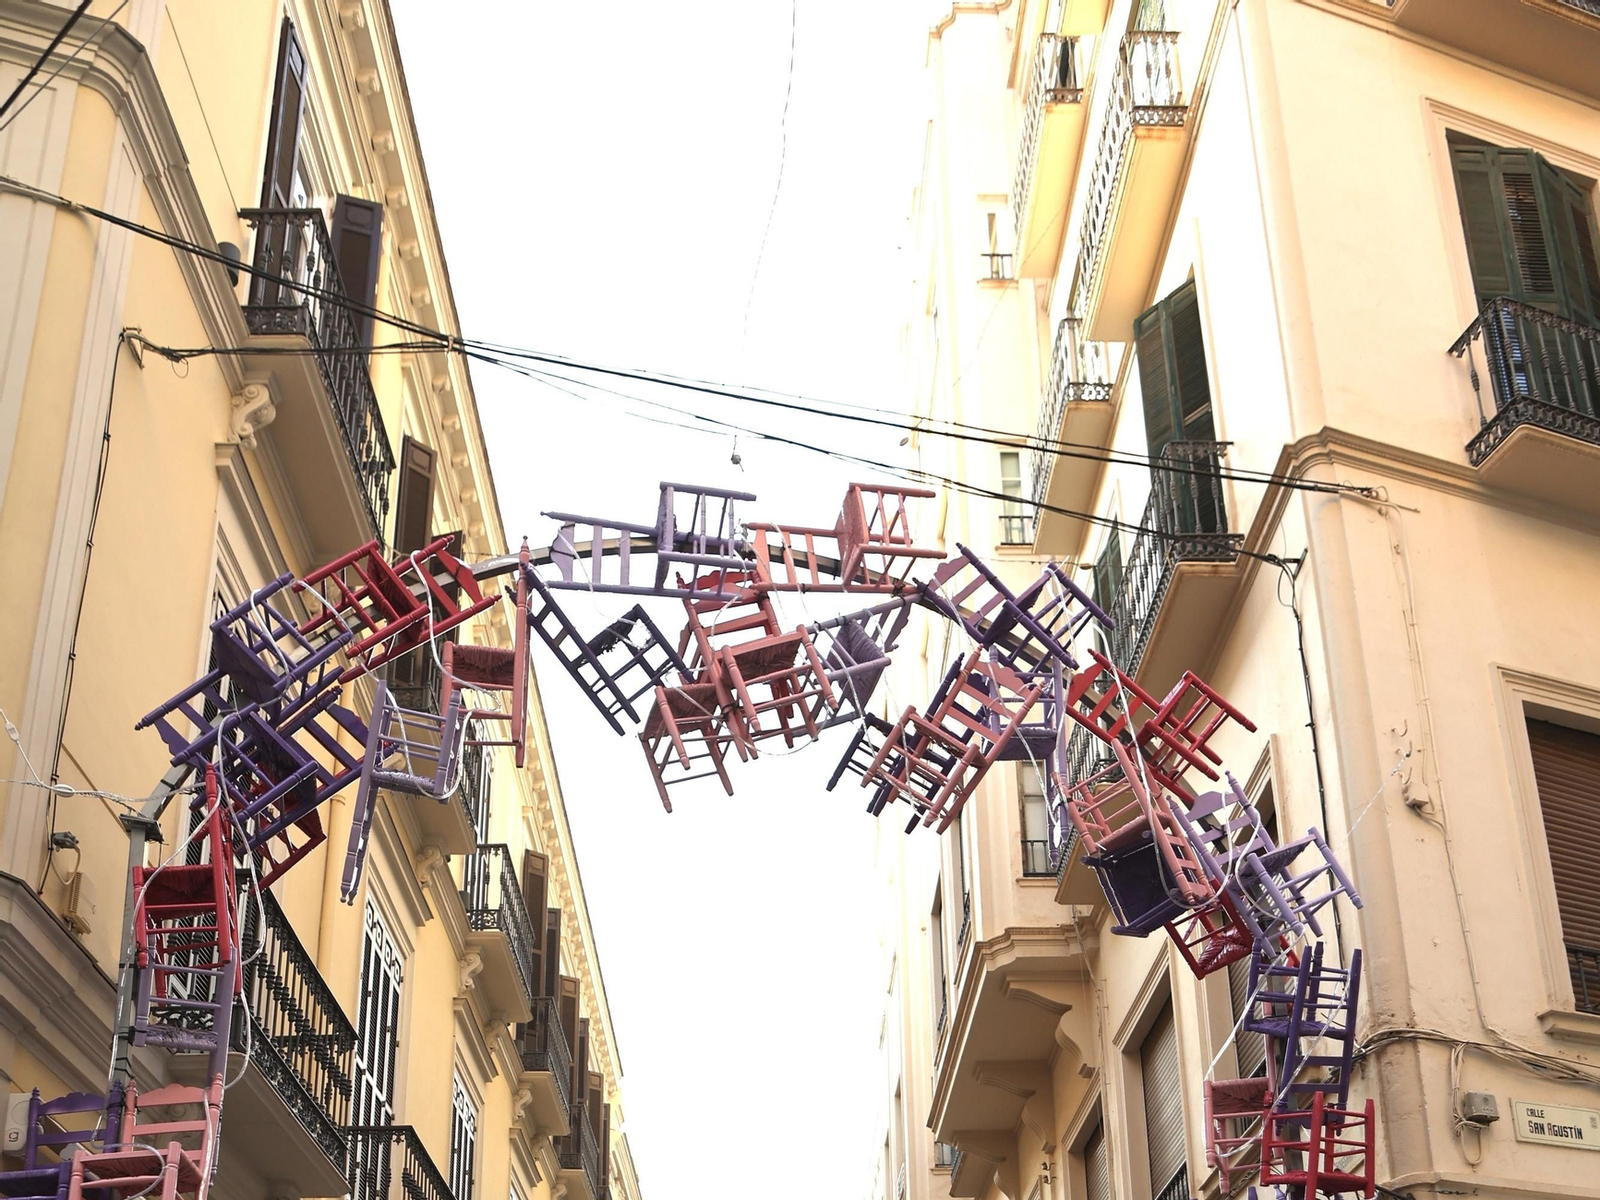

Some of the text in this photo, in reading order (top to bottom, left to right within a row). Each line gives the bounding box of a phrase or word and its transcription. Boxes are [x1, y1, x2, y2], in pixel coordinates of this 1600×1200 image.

[1526, 1108, 1545, 1119] CALLE
[1528, 1120, 1584, 1140] SAN AGUSTÍN
